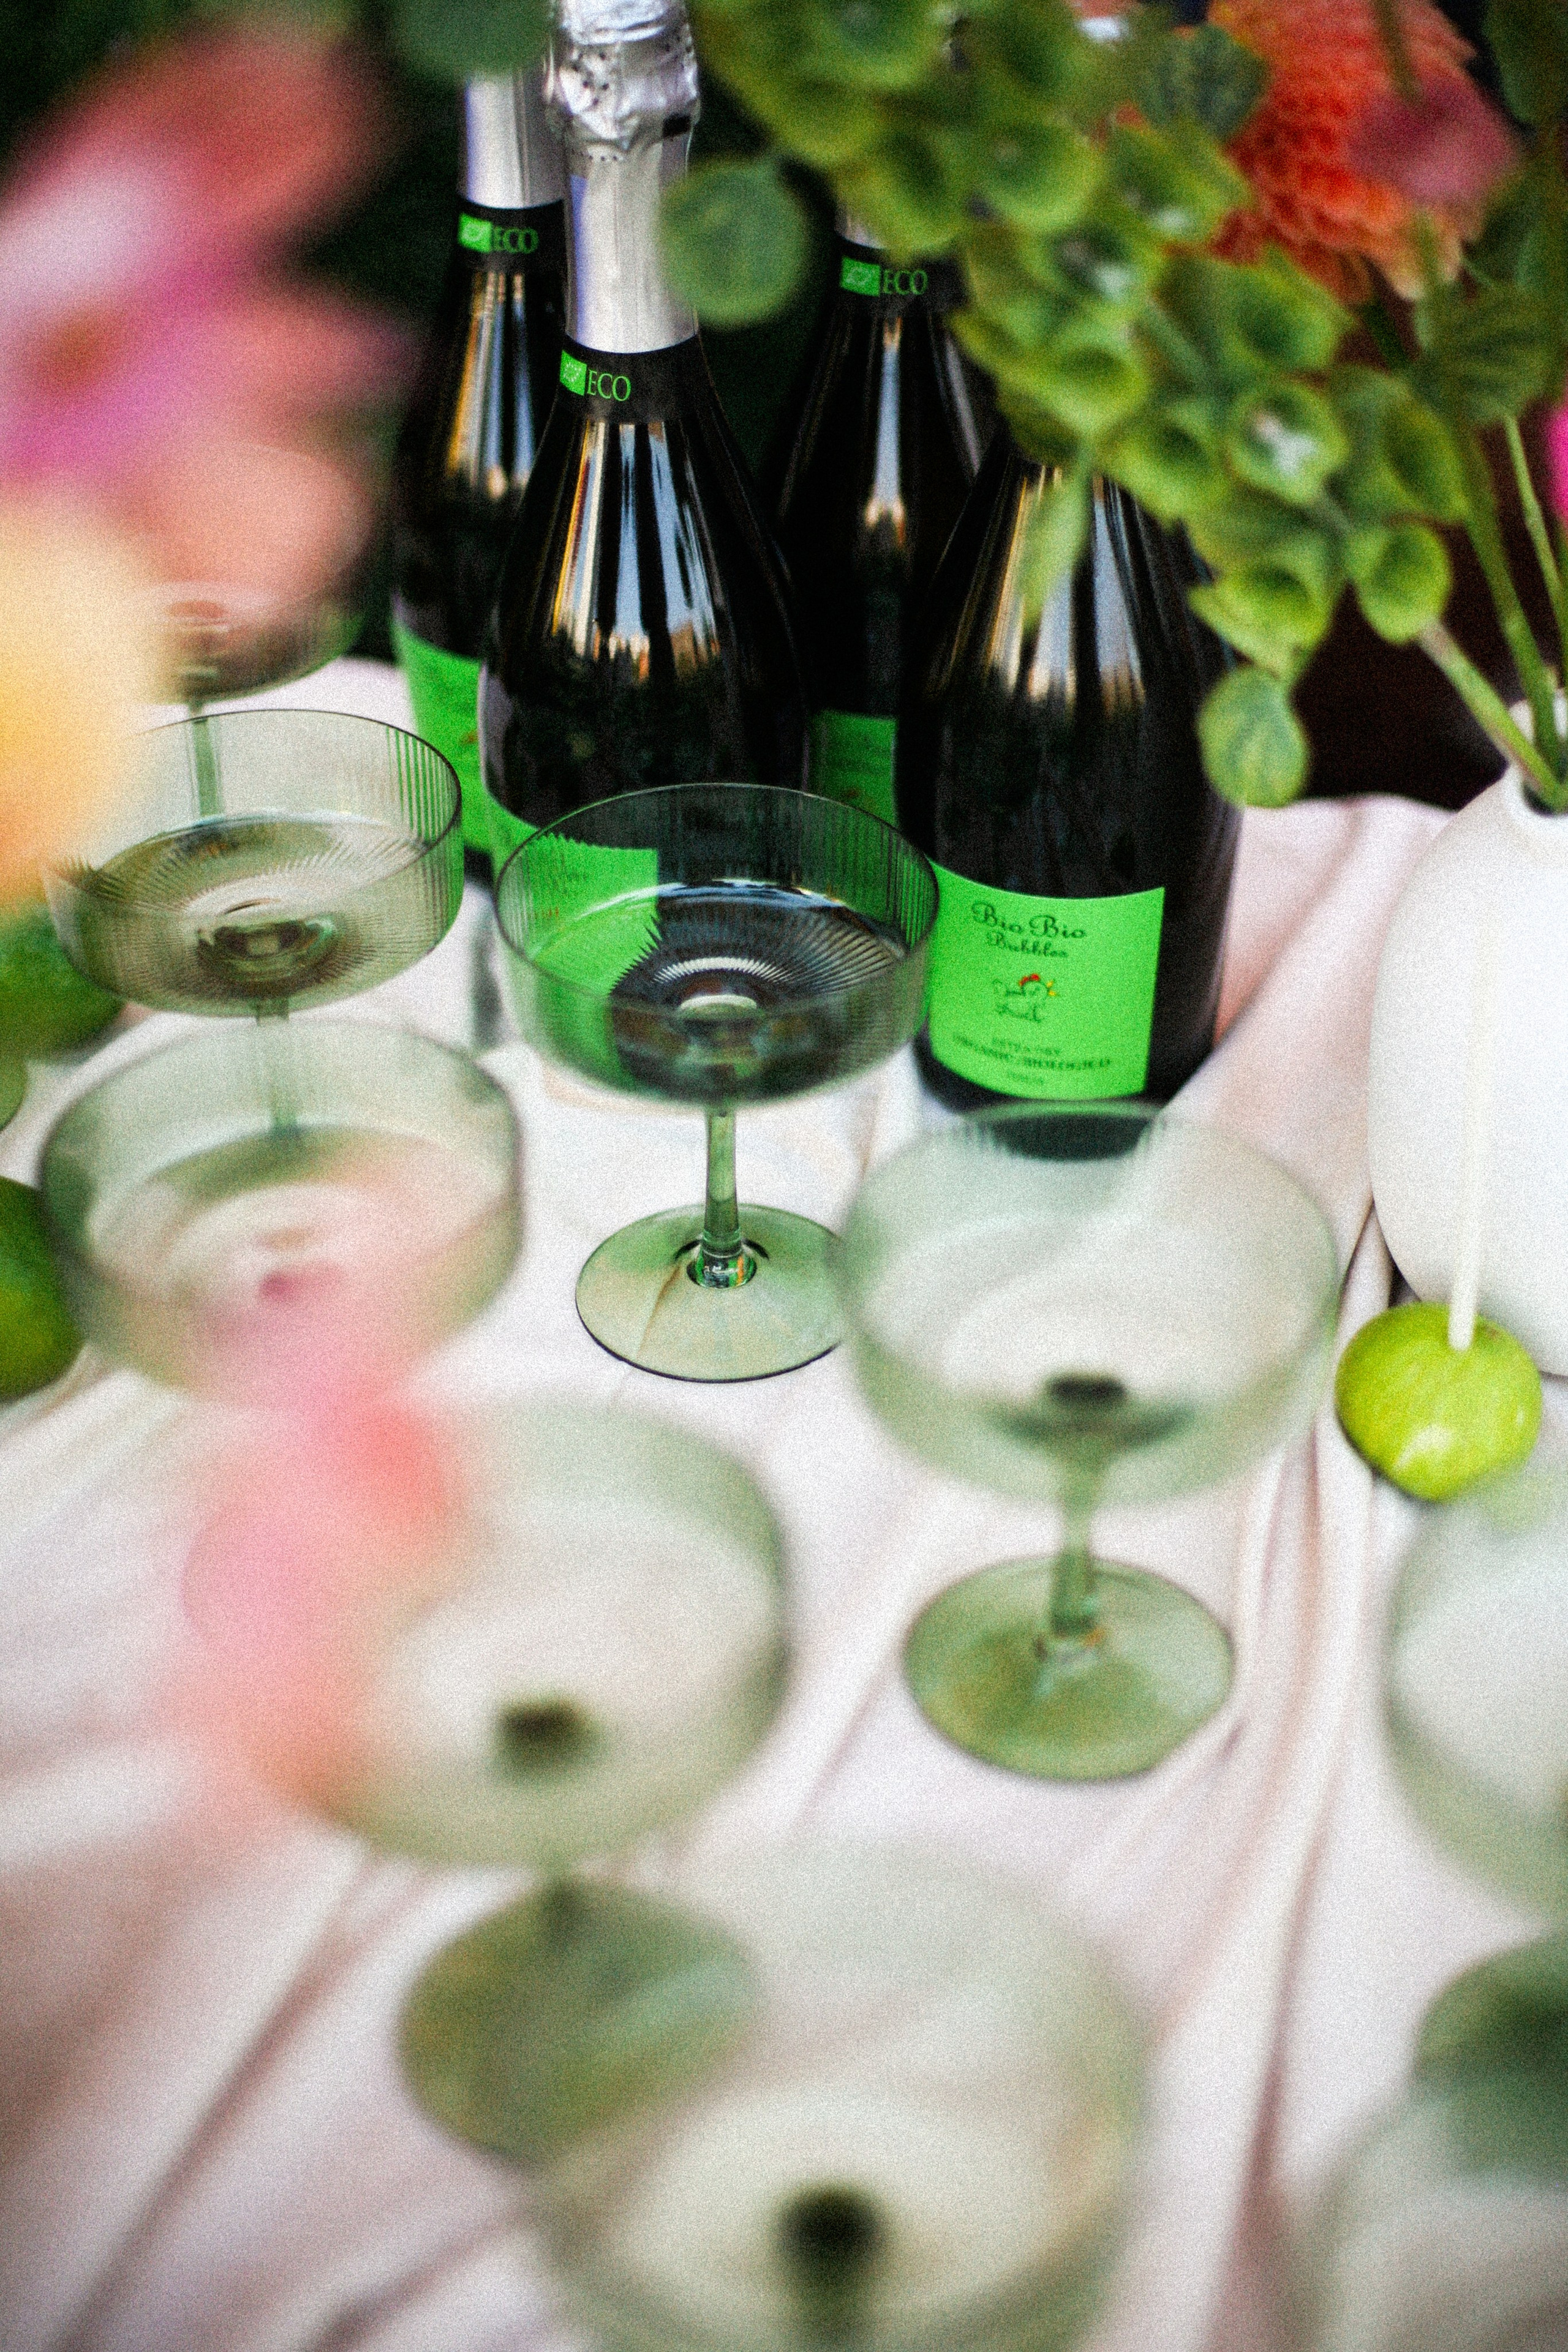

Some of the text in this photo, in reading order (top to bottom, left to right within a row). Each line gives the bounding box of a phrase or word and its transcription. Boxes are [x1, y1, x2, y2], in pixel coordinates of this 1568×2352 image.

[493, 225, 540, 254] ECO
[882, 270, 929, 296] ECO
[586, 369, 632, 402] ECO
[971, 900, 1088, 939] Bio Bio
